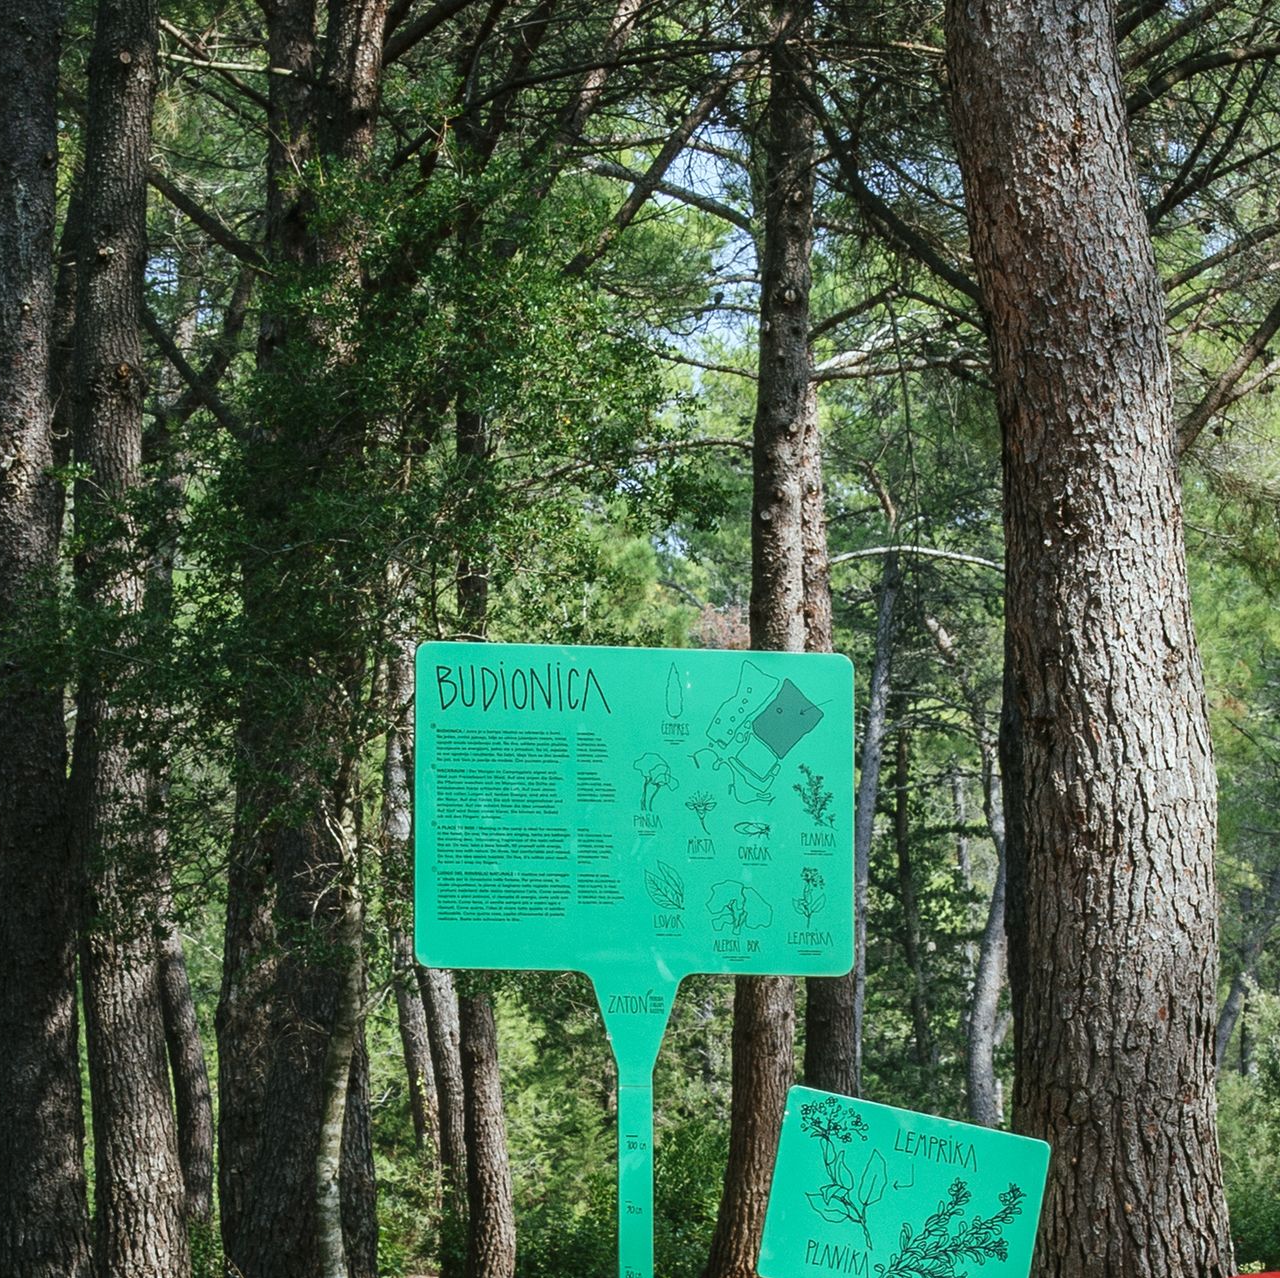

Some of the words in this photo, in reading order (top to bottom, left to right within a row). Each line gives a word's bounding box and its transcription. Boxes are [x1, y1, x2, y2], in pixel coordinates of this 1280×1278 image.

[436, 660, 612, 714] BUDIONICA
[687, 835, 716, 855] MIRTA
[800, 831, 836, 848] PLANIKA
[653, 914, 685, 929] LOVOR
[787, 928, 834, 947] LEMPRIKA
[608, 990, 651, 1014] ZATON
[894, 1128, 978, 1173] LEMPRIKA
[805, 1239, 869, 1278] PLANIKA
